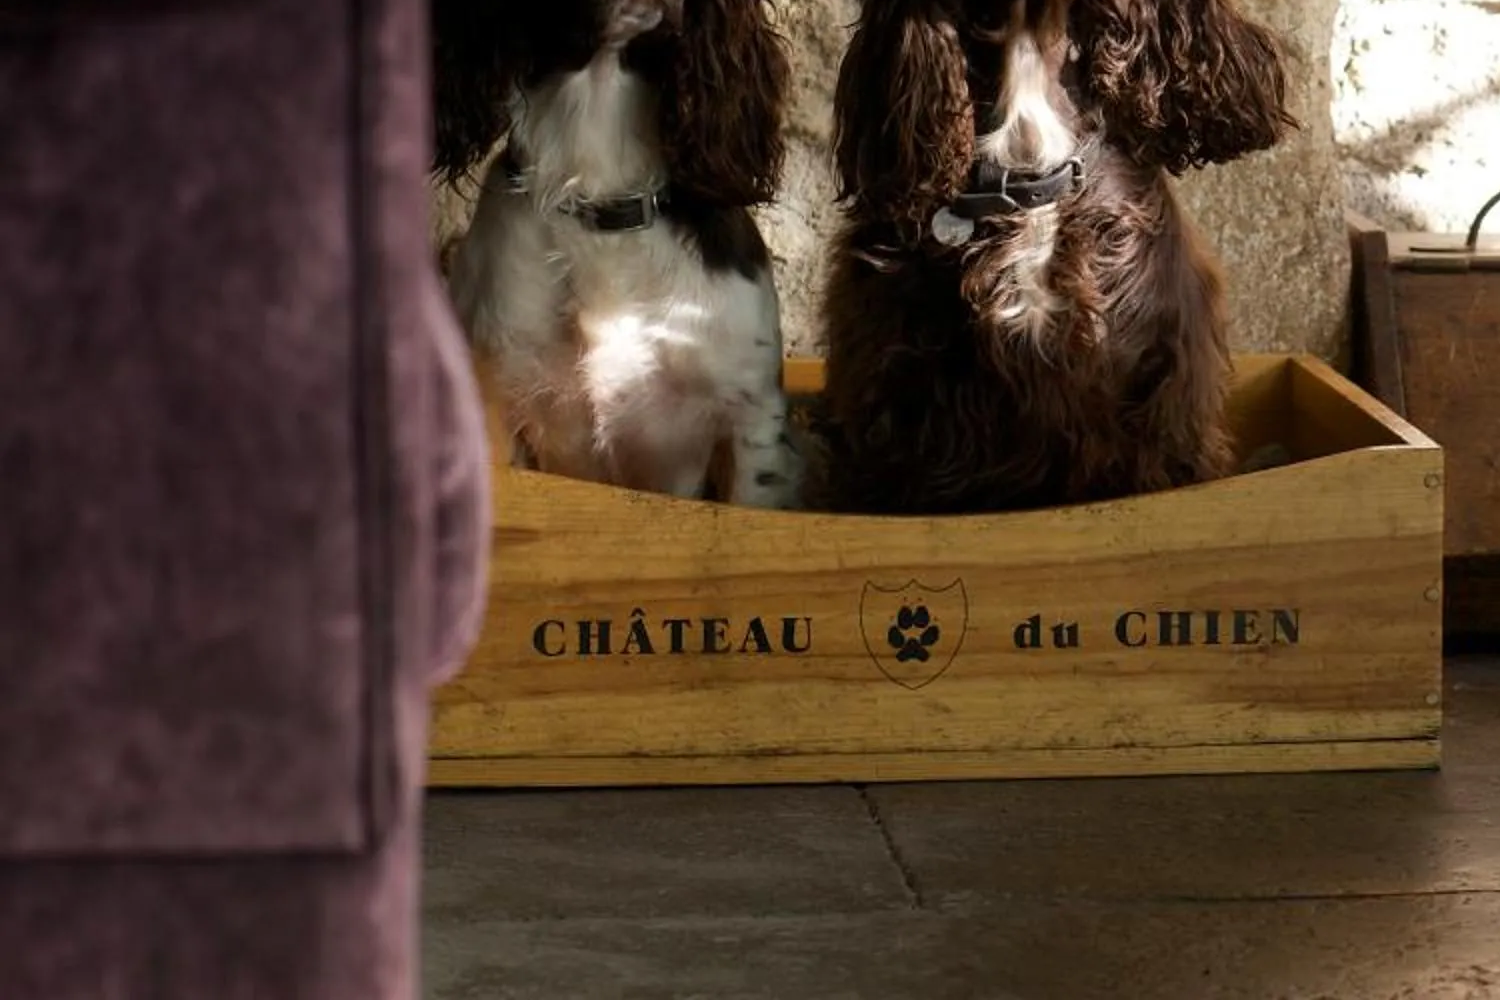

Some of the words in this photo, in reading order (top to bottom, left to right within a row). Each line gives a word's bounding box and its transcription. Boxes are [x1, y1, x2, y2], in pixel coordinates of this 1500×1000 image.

[532, 607, 814, 657] CHÂTEAU
[1012, 613, 1081, 649] du
[1114, 609, 1300, 647] CHIEN
